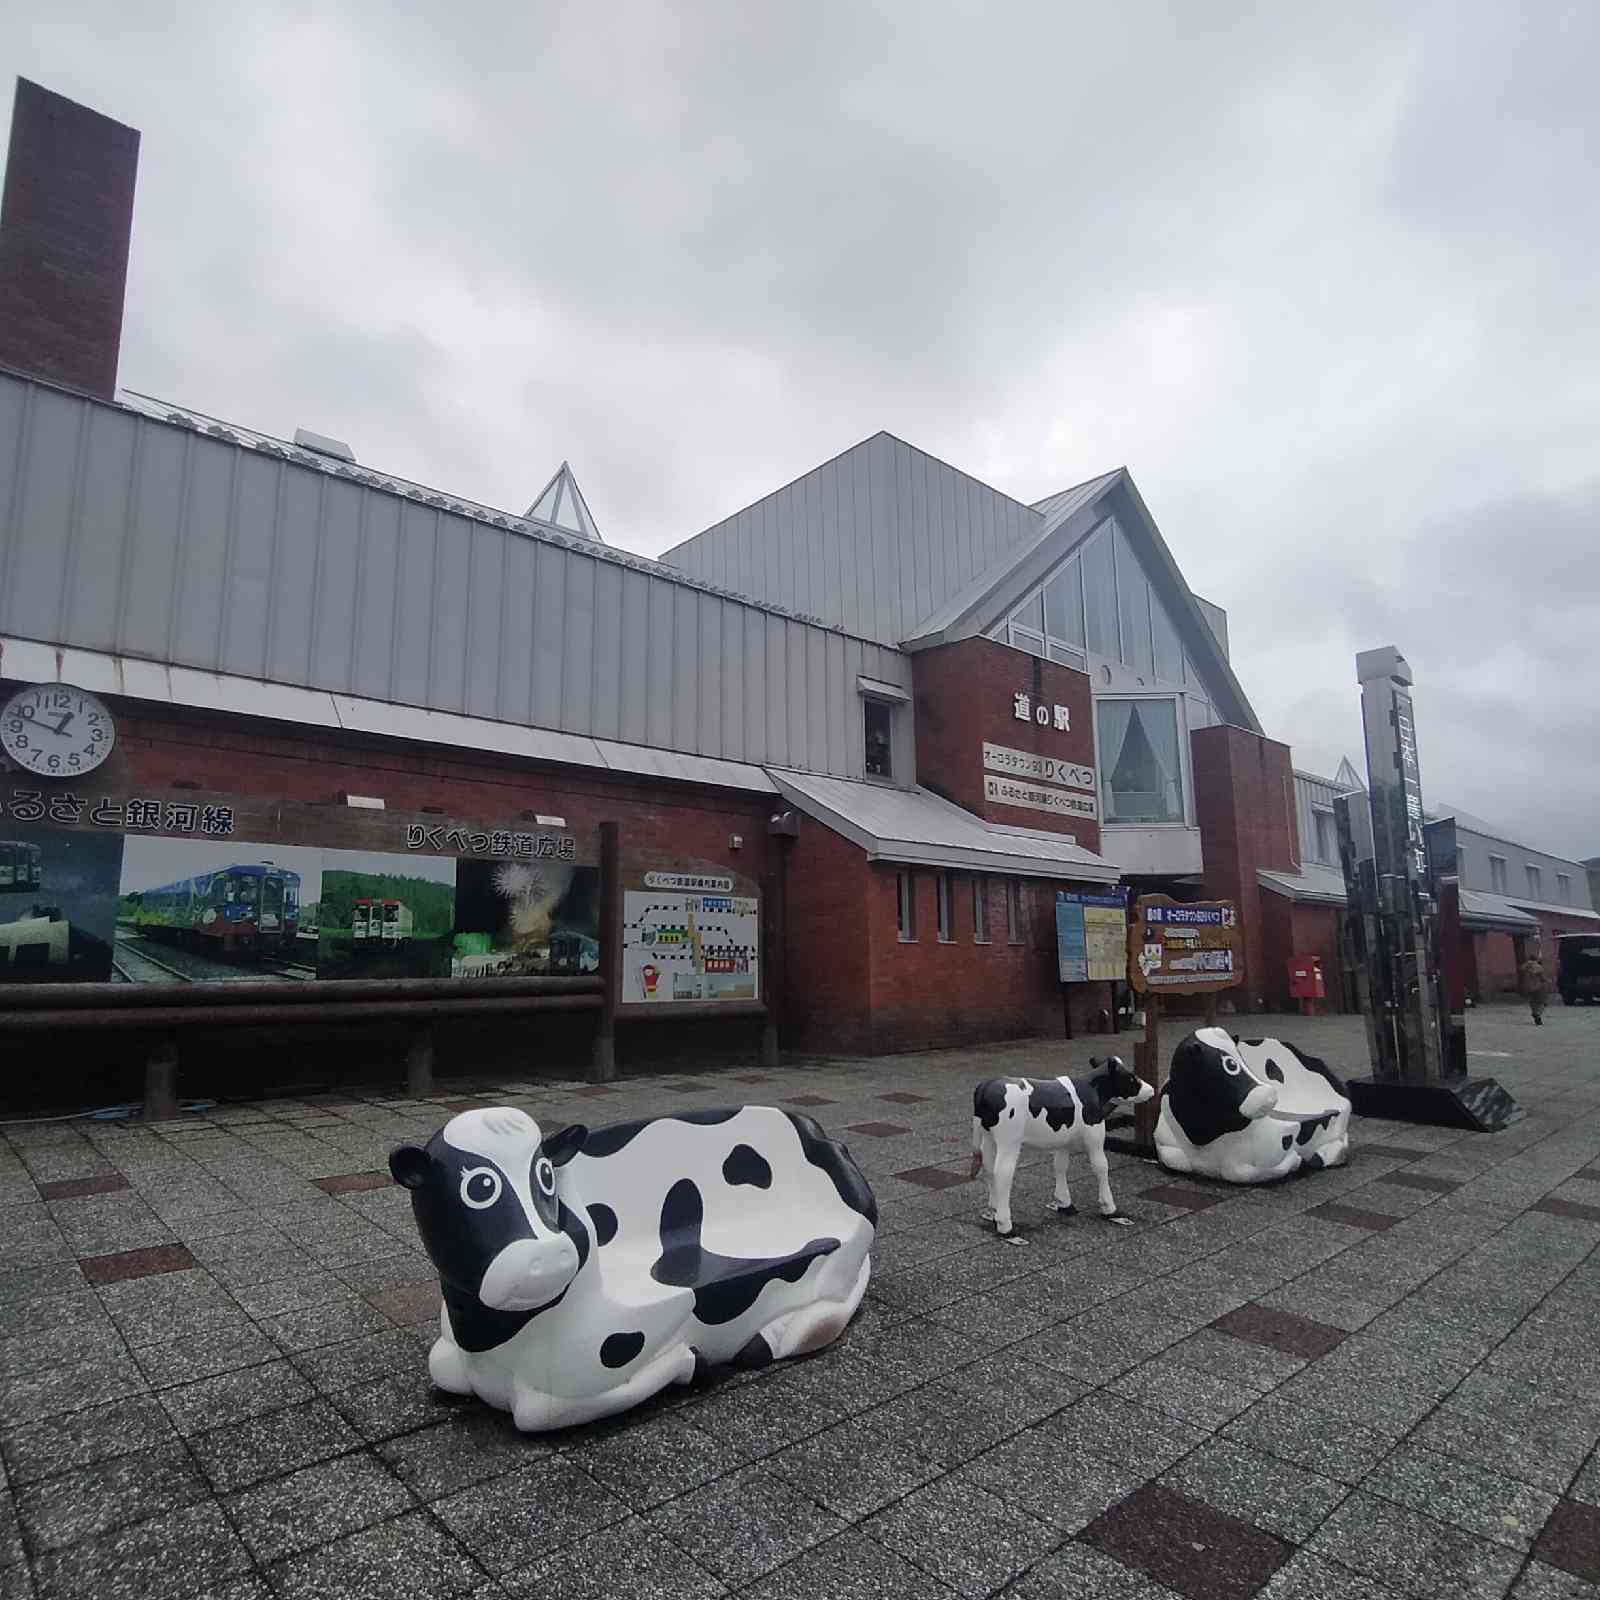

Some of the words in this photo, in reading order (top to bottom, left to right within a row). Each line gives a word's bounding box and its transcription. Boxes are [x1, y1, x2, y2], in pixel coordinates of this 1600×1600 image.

[36, 692, 50, 709] 11
[54, 694, 71, 709] 12
[1014, 691, 1071, 732] 道の駅
[10, 720, 23, 734] 9
[88, 712, 100, 727] 2
[15, 734, 28, 749] 8
[91, 728, 104, 742] 3
[31, 748, 43, 762] 7
[83, 743, 95, 756] 4
[47, 754, 61, 769] 6
[67, 752, 81, 767] 5
[0, 789, 235, 834] るさと銀河線
[407, 824, 576, 860] りくべつ鉄道広場
